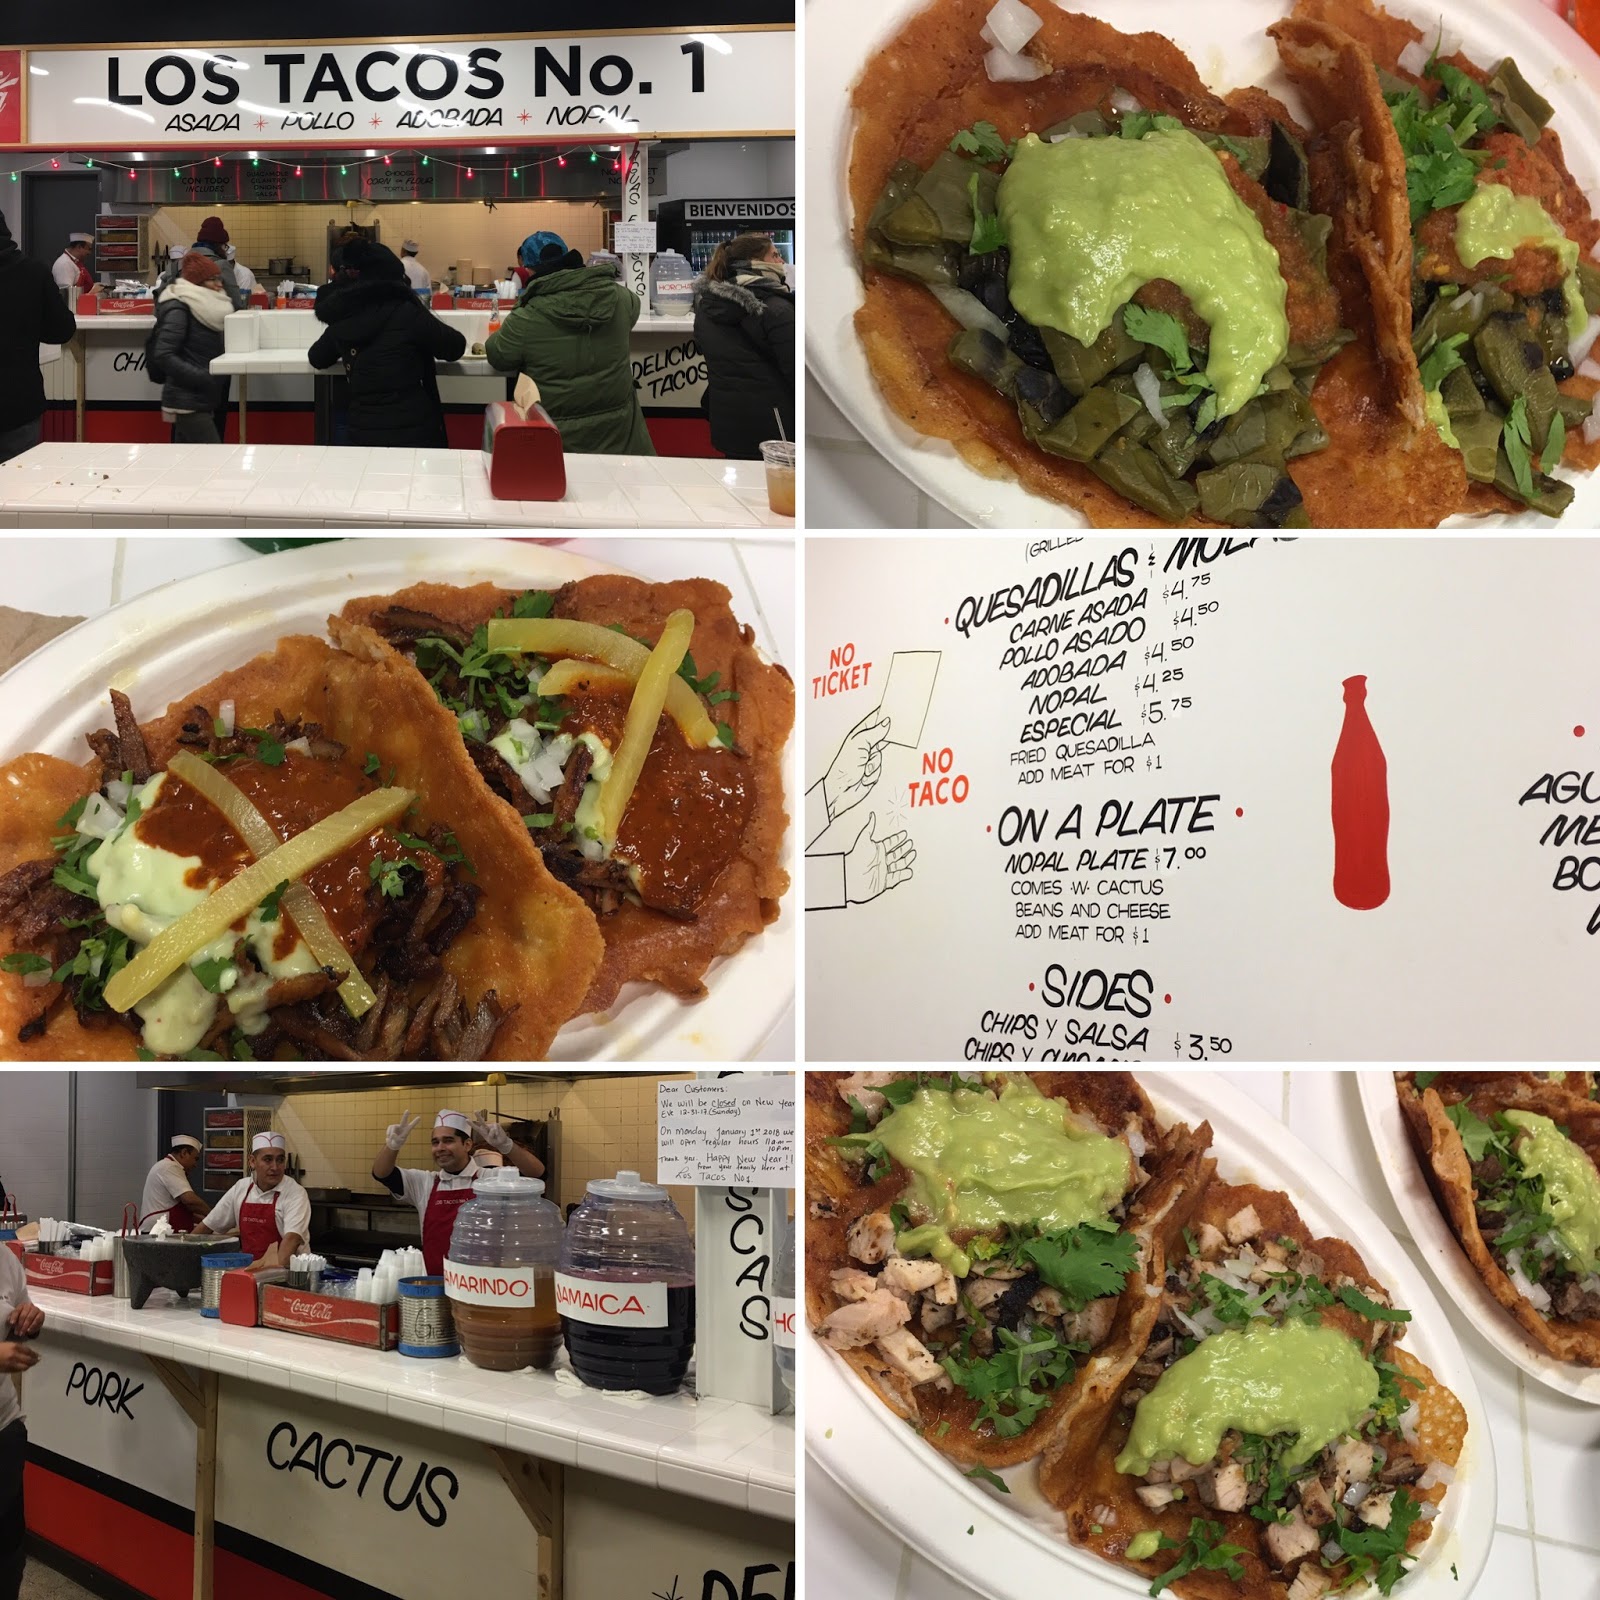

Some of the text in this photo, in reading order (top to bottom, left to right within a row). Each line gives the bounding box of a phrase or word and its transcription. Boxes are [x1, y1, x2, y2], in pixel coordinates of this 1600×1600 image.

[108, 41, 704, 106] LOS TACOS No. 1
[165, 104, 640, 132] ASADA POLLO ADOBADA NOPAL
[367, 177, 392, 185] CORN
[406, 176, 433, 185] FLOUR
[647, 361, 709, 399] TACOS
[955, 547, 1138, 639] QUESADILLAS
[1009, 609, 1075, 644] CARNE
[1078, 588, 1148, 626] ASADA
[830, 643, 855, 669] NO
[999, 638, 1060, 670] POLLO
[1062, 616, 1146, 655] ASADO
[813, 662, 872, 699] TICKET
[1020, 650, 1128, 690] ADOBADA
[1028, 683, 1108, 715] NOPAL
[1020, 708, 1123, 744] ESPECIAL
[922, 747, 953, 775] NO
[1010, 732, 1156, 766] FRIED QUESADILLA
[1017, 769, 1044, 785] ADD
[1050, 762, 1095, 781] MEAT
[1104, 756, 1135, 775] FOR
[908, 775, 969, 808] TACO
[998, 794, 1221, 847] ON A PLATE
[1004, 851, 1069, 875] NOPAL
[1076, 848, 1149, 871] PLATE
[1011, 880, 1063, 896] COMES
[1097, 879, 1164, 896] CACTUS
[1015, 902, 1171, 919] BEANS AND CHEESE
[1015, 924, 1042, 939] ADD
[1049, 925, 1089, 941] MEAT
[1096, 926, 1125, 943] FOR
[1041, 963, 1154, 1019] SIDES
[980, 1010, 1039, 1040] CHIPS
[1045, 1018, 1058, 1040] Y
[1065, 1018, 1149, 1052] SALSA
[964, 1037, 1015, 1062] CHIPS
[659, 1084, 679, 1094] Dear
[660, 1100, 673, 1108] We
[677, 1099, 694, 1107] will
[698, 1098, 707, 1107] be
[711, 1098, 736, 1109] closed
[742, 1099, 751, 1107] on
[755, 1097, 774, 1106] New
[660, 1126, 672, 1136] On
[762, 1128, 780, 1136] 2018
[705, 1139, 731, 1148] regular
[738, 1137, 759, 1146] hours
[675, 1166, 692, 1179] Los
[699, 1172, 726, 1181] Tacos
[706, 1152, 731, 1163] Happy
[737, 1154, 756, 1164] New
[556, 1284, 645, 1315] JAMAICA
[66, 1362, 144, 1420] PORK
[267, 1421, 459, 1527] CACTUS
